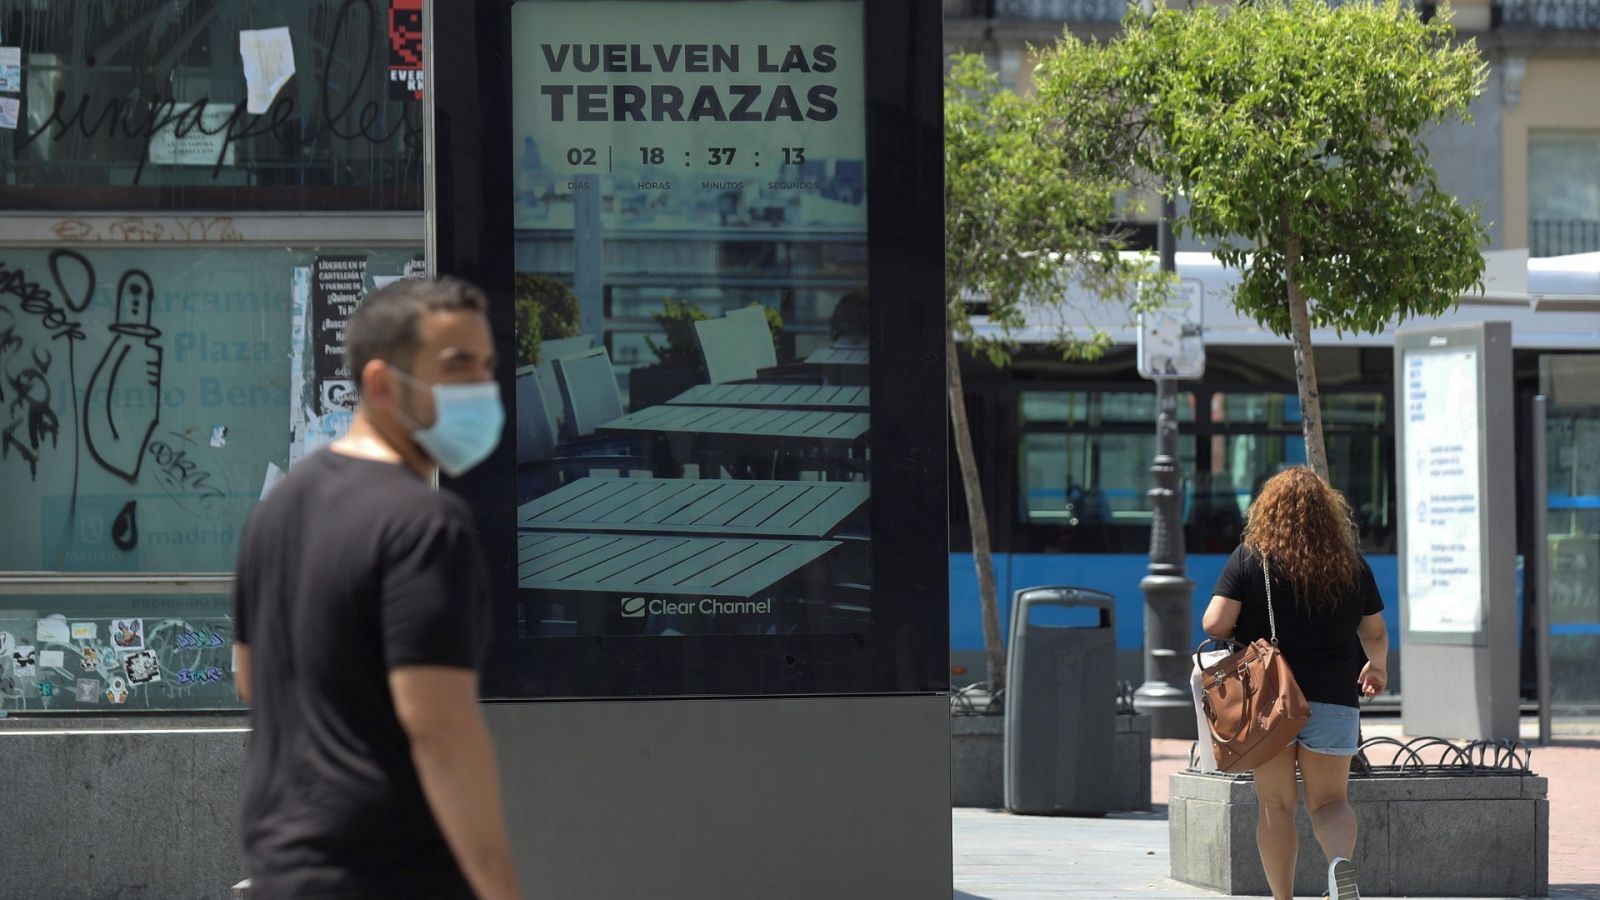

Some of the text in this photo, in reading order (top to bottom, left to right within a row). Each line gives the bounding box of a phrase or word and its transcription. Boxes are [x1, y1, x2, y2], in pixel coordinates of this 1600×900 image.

[541, 43, 838, 73] VUELVEN LAS
[541, 84, 839, 122] TERRAZAS
[567, 148, 597, 165] 02
[639, 147, 664, 165] 18
[707, 147, 737, 166] 37
[781, 147, 806, 165] 13
[637, 181, 671, 190] HORAS
[701, 181, 744, 190] MINUTOS
[767, 181, 819, 190] SEGUNDOS
[174, 332, 273, 362] Plaza
[147, 527, 234, 546] madrid
[648, 598, 771, 615] Clear Channel
